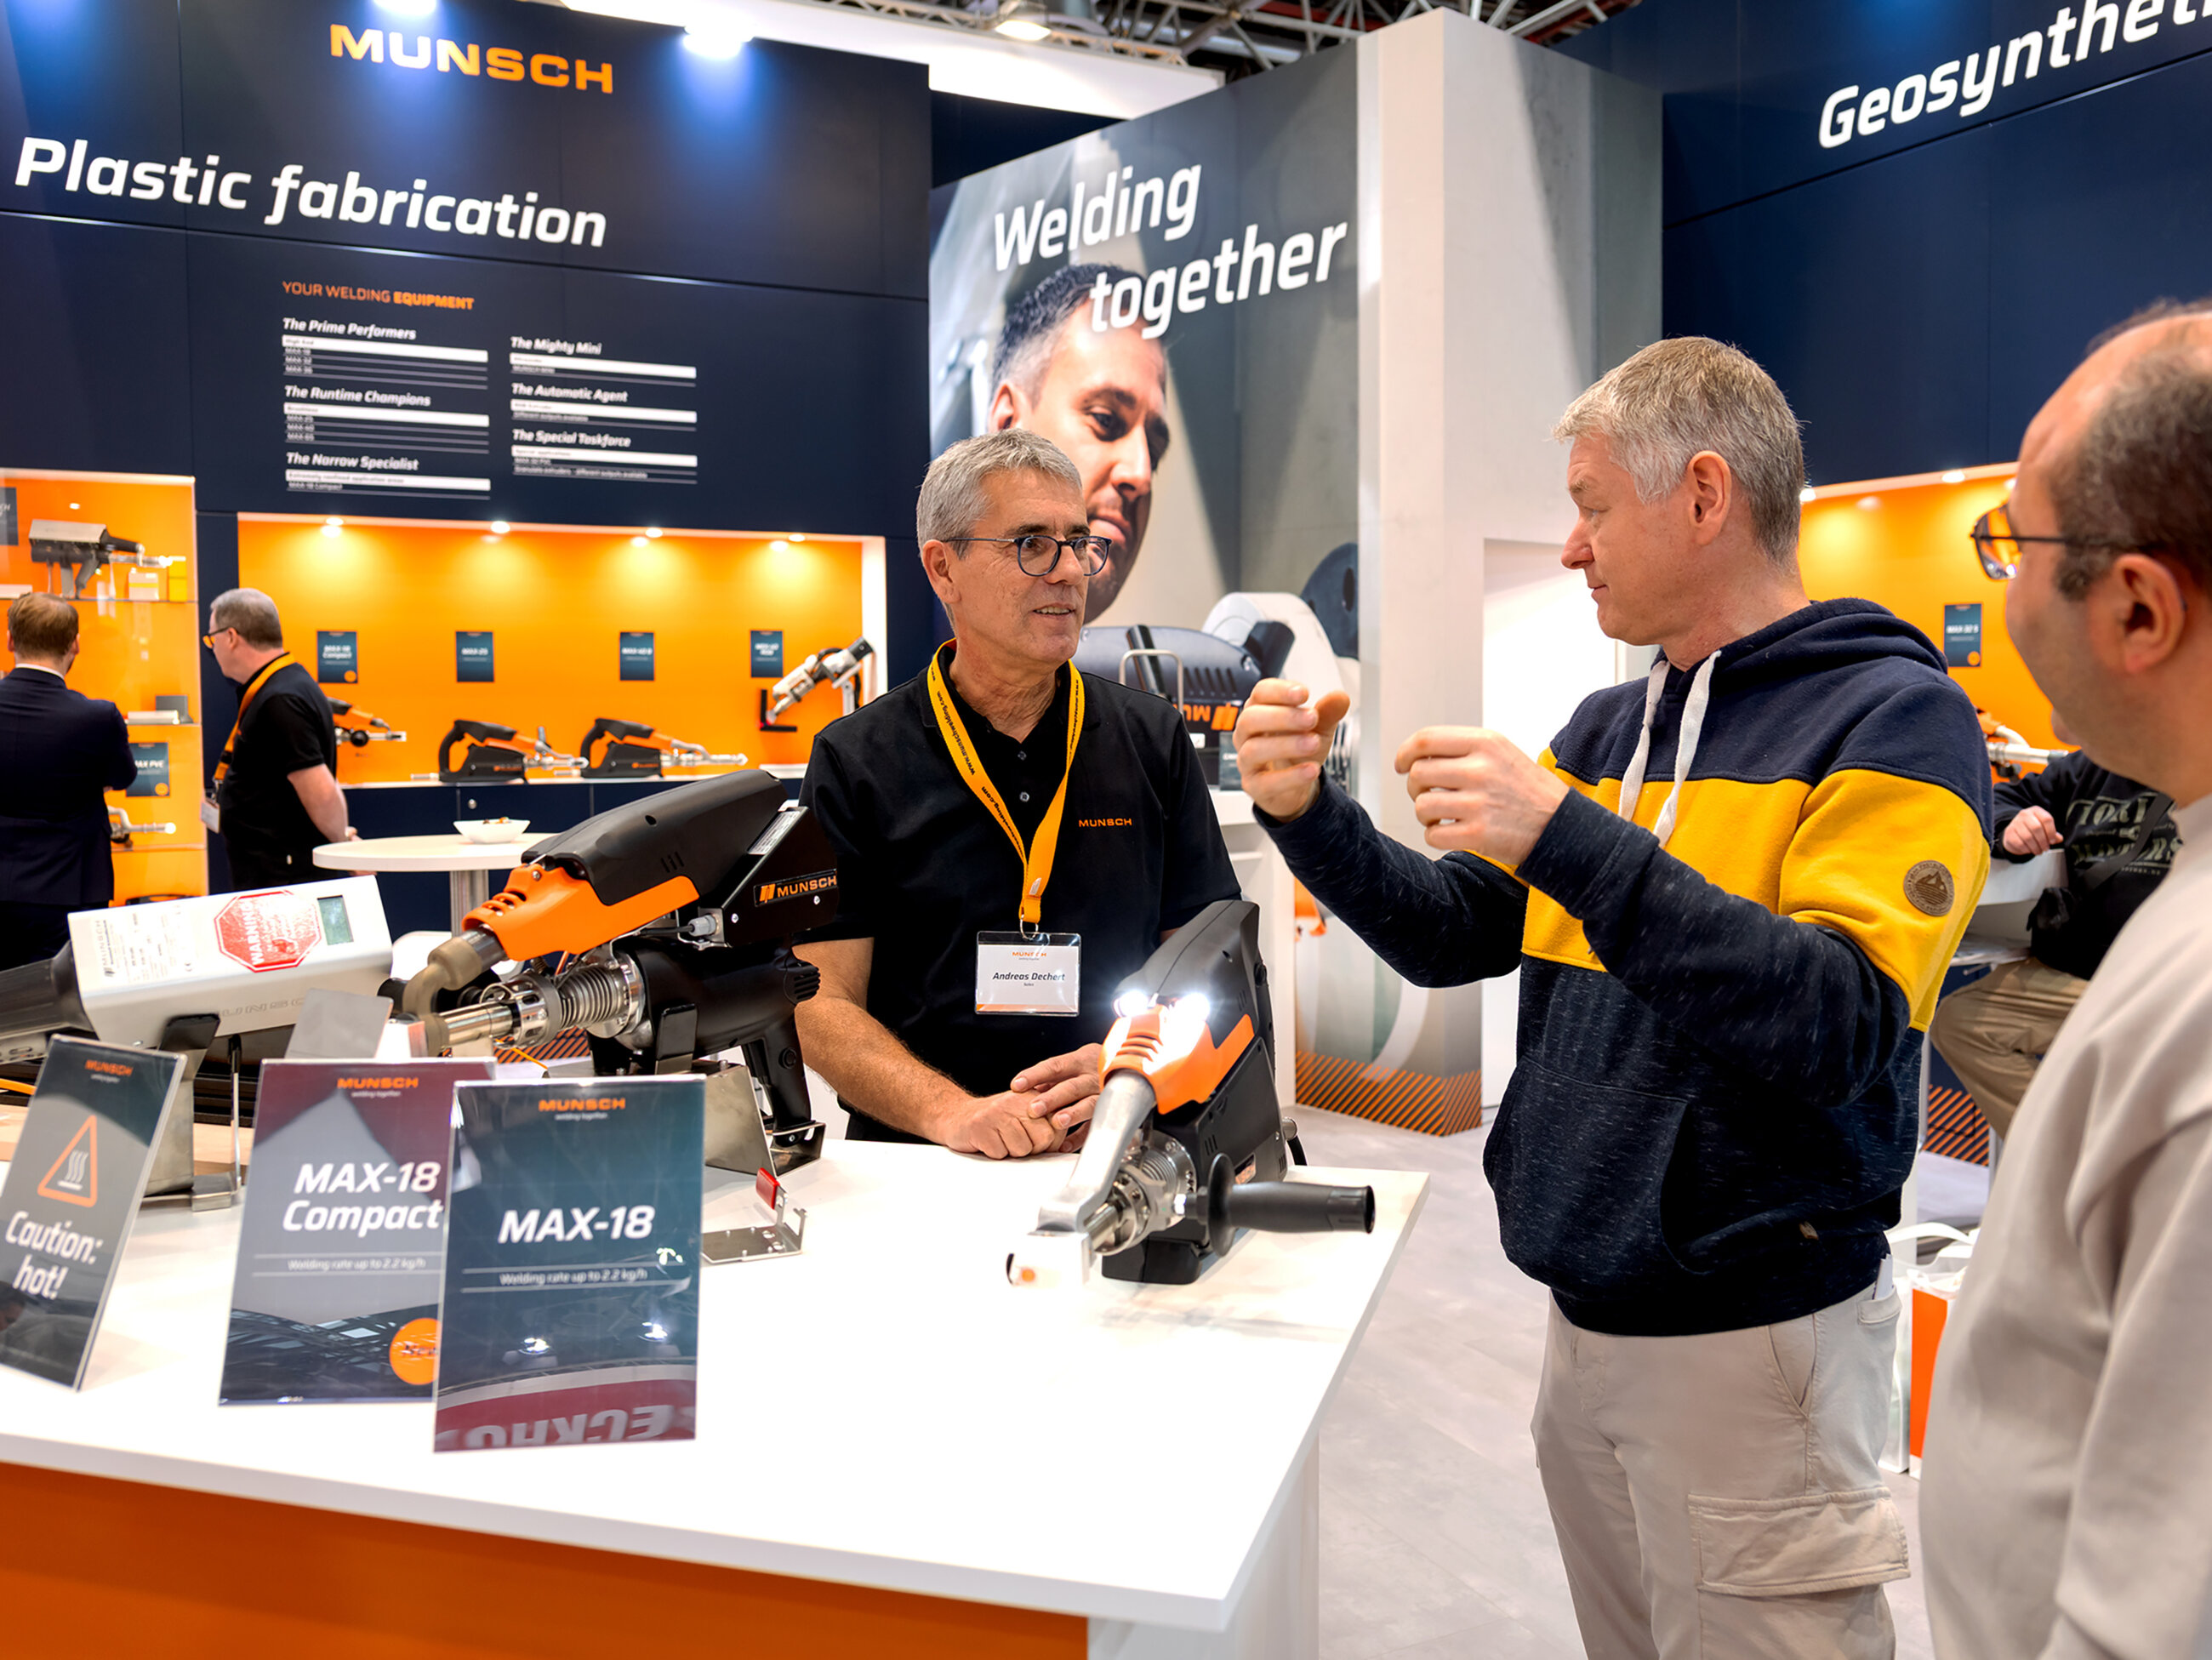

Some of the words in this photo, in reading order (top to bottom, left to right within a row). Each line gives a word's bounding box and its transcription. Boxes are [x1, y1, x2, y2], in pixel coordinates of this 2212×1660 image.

[330, 24, 614, 94] MUNSCH
[14, 136, 252, 209] Plastic
[265, 163, 607, 248] fabrication
[995, 163, 1202, 271] Welding
[1090, 221, 1348, 339] together
[282, 281, 322, 296] YOUR
[326, 284, 391, 303] WELDING
[393, 291, 475, 310] EQUIPMENT
[282, 317, 306, 332] The
[308, 320, 345, 335] Prime
[347, 322, 417, 340] Performers
[511, 337, 533, 350] The
[533, 339, 574, 355] Mighty
[576, 343, 602, 356] Mini
[284, 385, 308, 398] The
[311, 387, 362, 402] Runtime
[364, 391, 431, 408] Champions
[512, 383, 533, 395] The
[534, 385, 593, 400] Automatic
[594, 389, 628, 403] Agent
[512, 429, 533, 442] The
[535, 431, 577, 445] Special
[579, 433, 631, 448] Taskforce
[286, 452, 310, 465] The
[311, 454, 358, 468] Narrow
[360, 456, 419, 471] Specialist
[1078, 817, 1133, 830] MUNSCH
[777, 876, 837, 898] MUNSCH
[992, 972, 1029, 981] Andreas
[1030, 973, 1065, 981] Dechert
[84, 1058, 134, 1077] MUNSCH
[336, 1077, 419, 1090] MUNSCH
[539, 1098, 626, 1112] MUNSCH
[294, 1161, 442, 1195] MAX-18
[282, 1199, 443, 1237] Compact
[498, 1206, 656, 1245] MAX-18
[5, 1211, 103, 1265] Caution:
[288, 1258, 330, 1271] Welding
[331, 1259, 353, 1270] rate
[354, 1260, 369, 1270] up
[370, 1258, 382, 1269] to
[382, 1258, 401, 1269] 2.2
[401, 1258, 426, 1270] kg/h
[13, 1255, 68, 1299] hot!
[499, 1272, 545, 1286] Welding
[547, 1272, 569, 1283] rate
[571, 1272, 587, 1283] up
[588, 1270, 601, 1281] to
[601, 1269, 620, 1281] 2.2
[620, 1268, 648, 1282] kg/h
